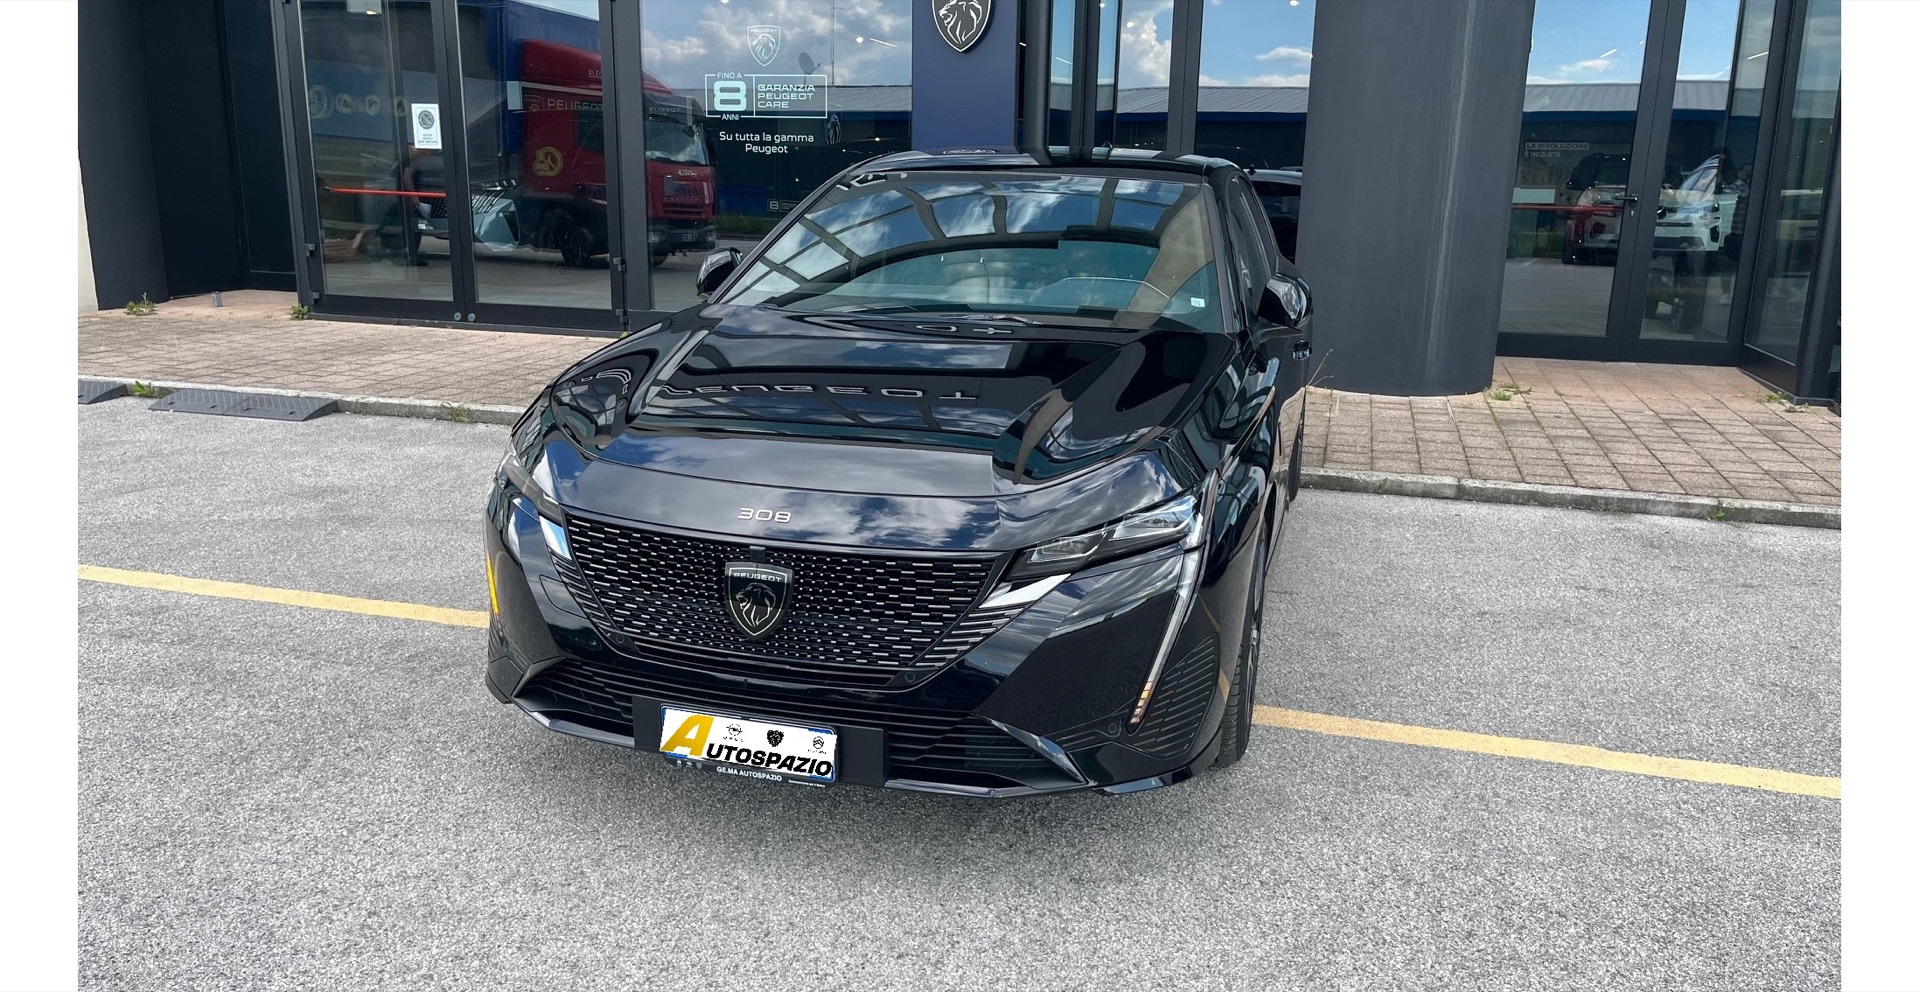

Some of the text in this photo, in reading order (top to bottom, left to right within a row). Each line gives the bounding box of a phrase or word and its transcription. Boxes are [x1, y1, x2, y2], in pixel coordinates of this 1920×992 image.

[758, 84, 815, 92] GARANZIA
[714, 81, 746, 111] 8
[758, 92, 814, 100] PEUGEOT
[719, 131, 814, 143] Su tutta la gamma
[745, 143, 788, 154] Peugeot
[737, 507, 792, 523] 308
[733, 572, 782, 583] PEUGEOT
[739, 770, 783, 781] AUTOSPAZIO
